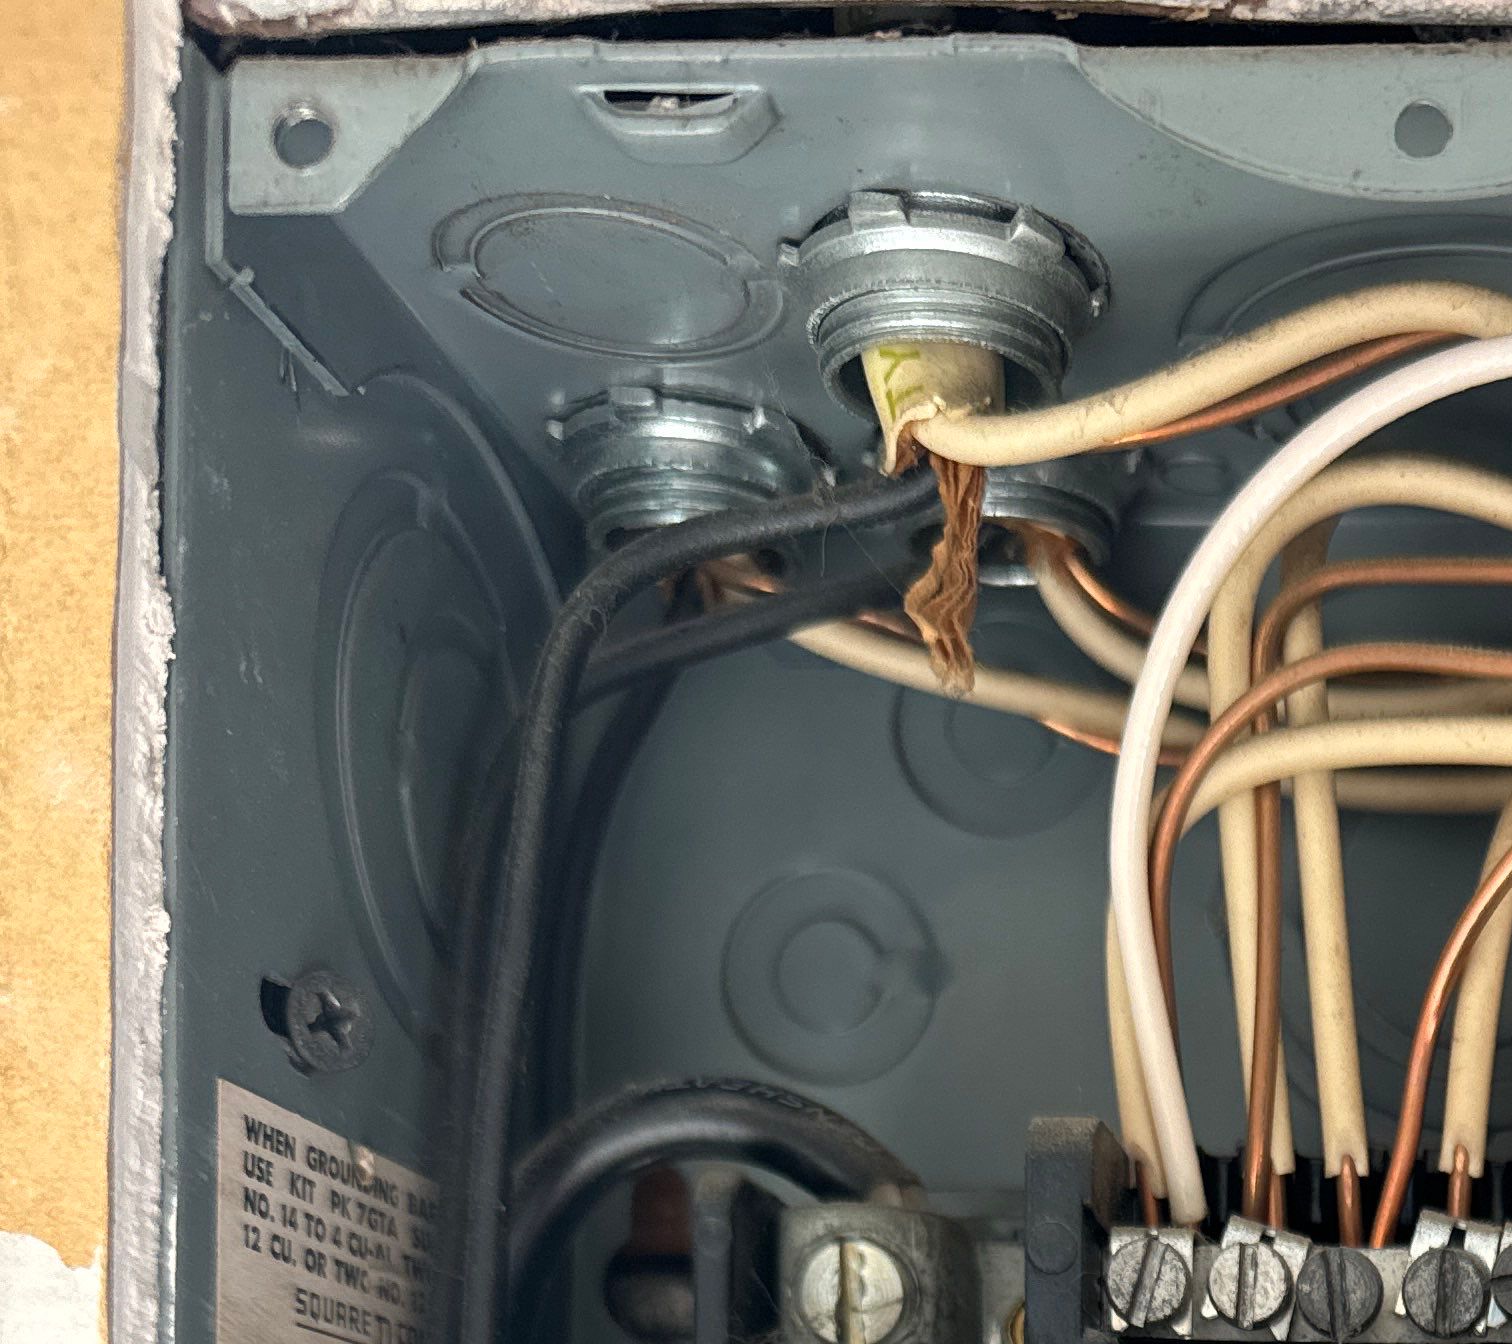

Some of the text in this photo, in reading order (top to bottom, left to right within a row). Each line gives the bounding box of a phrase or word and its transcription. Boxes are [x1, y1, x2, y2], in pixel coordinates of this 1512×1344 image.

[242, 1113, 297, 1163] WHEN
[306, 1145, 399, 1209] GROUNDING
[243, 1150, 274, 1188] USE
[289, 1170, 317, 1204] KIT
[243, 1186, 274, 1223] NO.
[281, 1203, 298, 1232] 14
[305, 1211, 327, 1244] TO
[332, 1222, 342, 1249] 4
[243, 1223, 262, 1255] 12
[270, 1233, 297, 1267] CU.
[304, 1247, 328, 1279] OR
[295, 1287, 372, 1338] SQUARE
